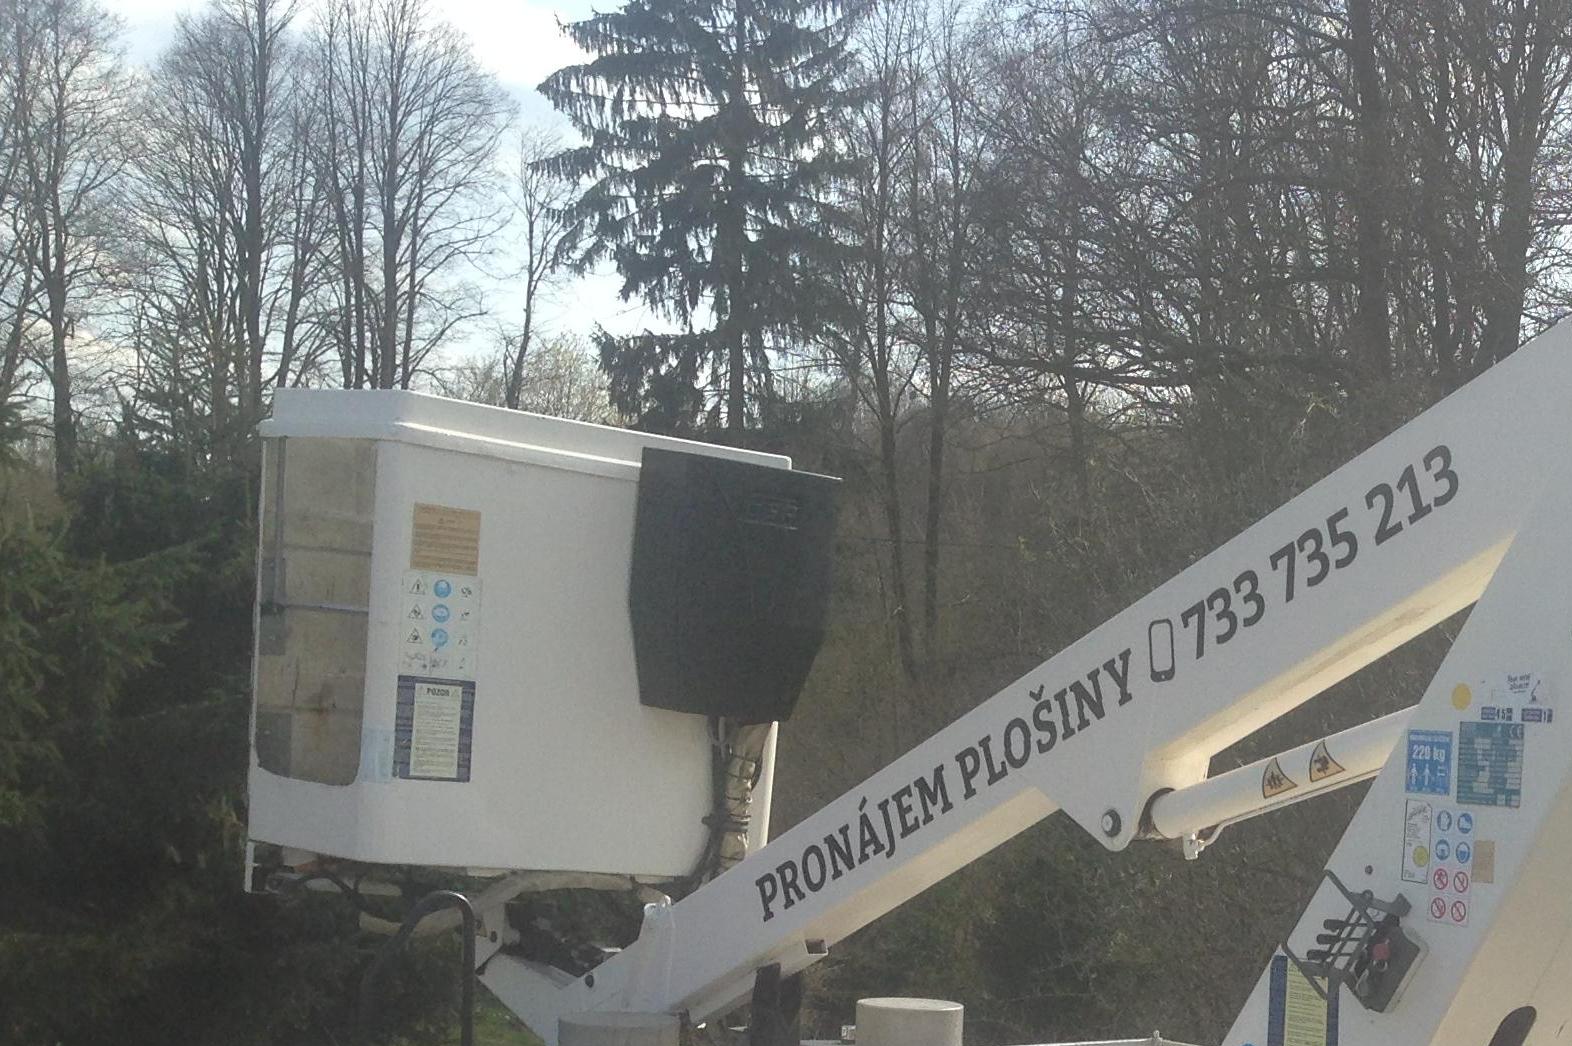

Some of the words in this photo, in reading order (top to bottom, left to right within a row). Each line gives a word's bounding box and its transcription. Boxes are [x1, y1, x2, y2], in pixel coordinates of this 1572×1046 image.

[755, 763, 954, 922] PRONÁJEM
[954, 647, 1133, 800] PLOŠINY
[1180, 569, 1266, 660] 733
[1269, 506, 1359, 604] 735
[1364, 444, 1460, 546] 213
[1412, 744, 1430, 760] 220
